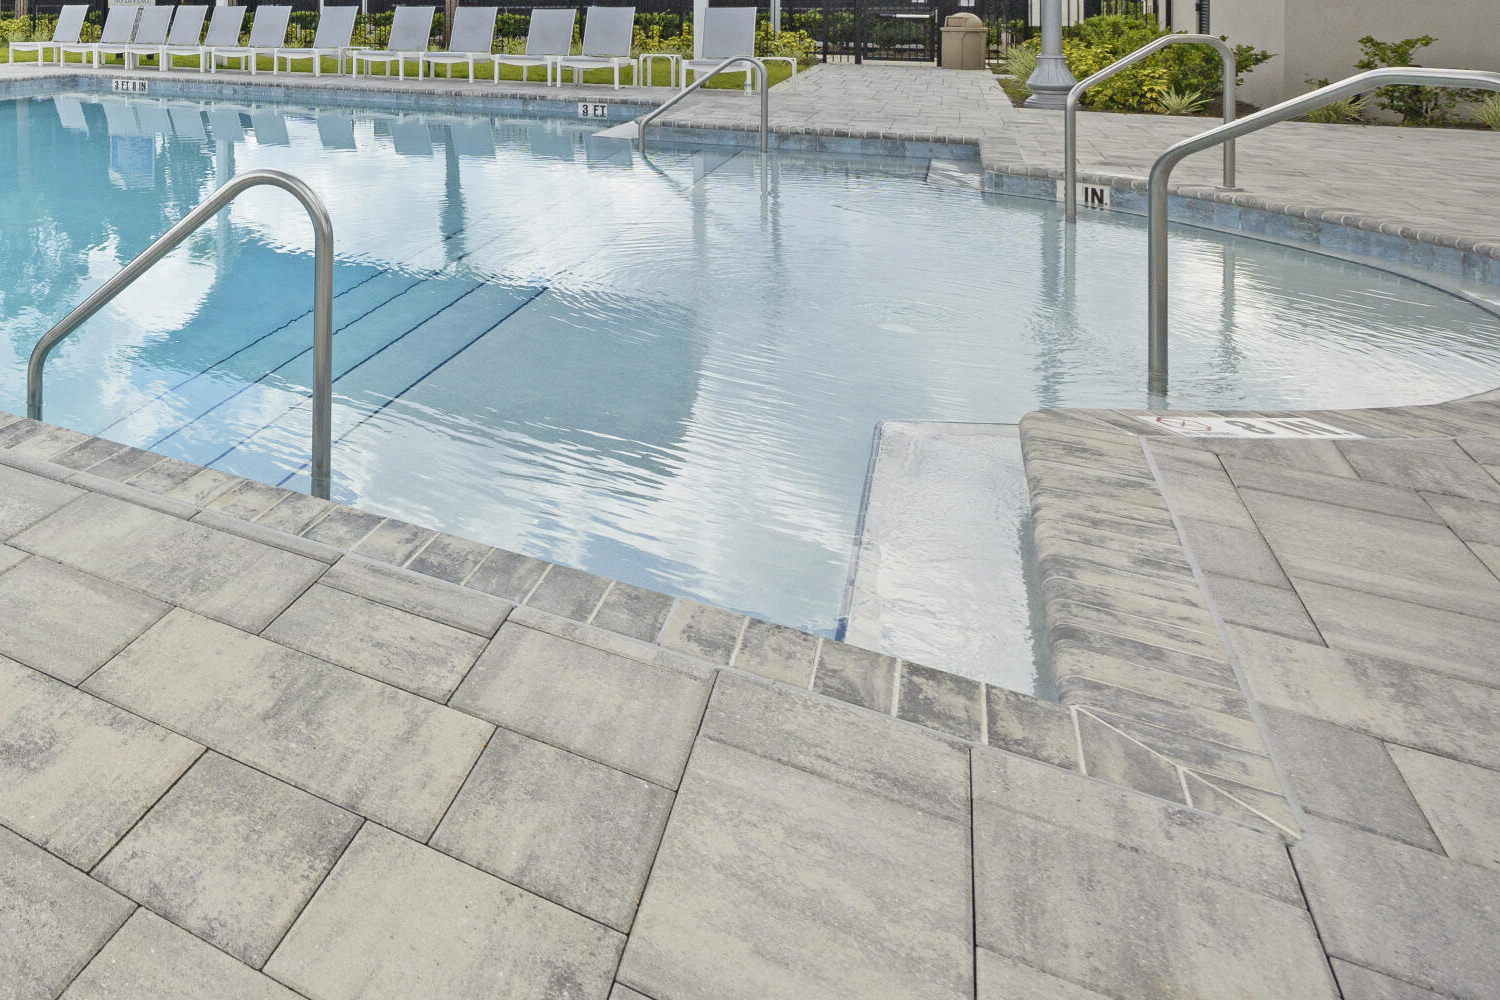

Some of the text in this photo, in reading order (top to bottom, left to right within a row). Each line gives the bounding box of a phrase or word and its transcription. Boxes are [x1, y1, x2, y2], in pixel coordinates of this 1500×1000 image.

[138, 81, 147, 92] IN
[582, 104, 606, 118] 3 FT
[1084, 186, 1108, 207] IN.
